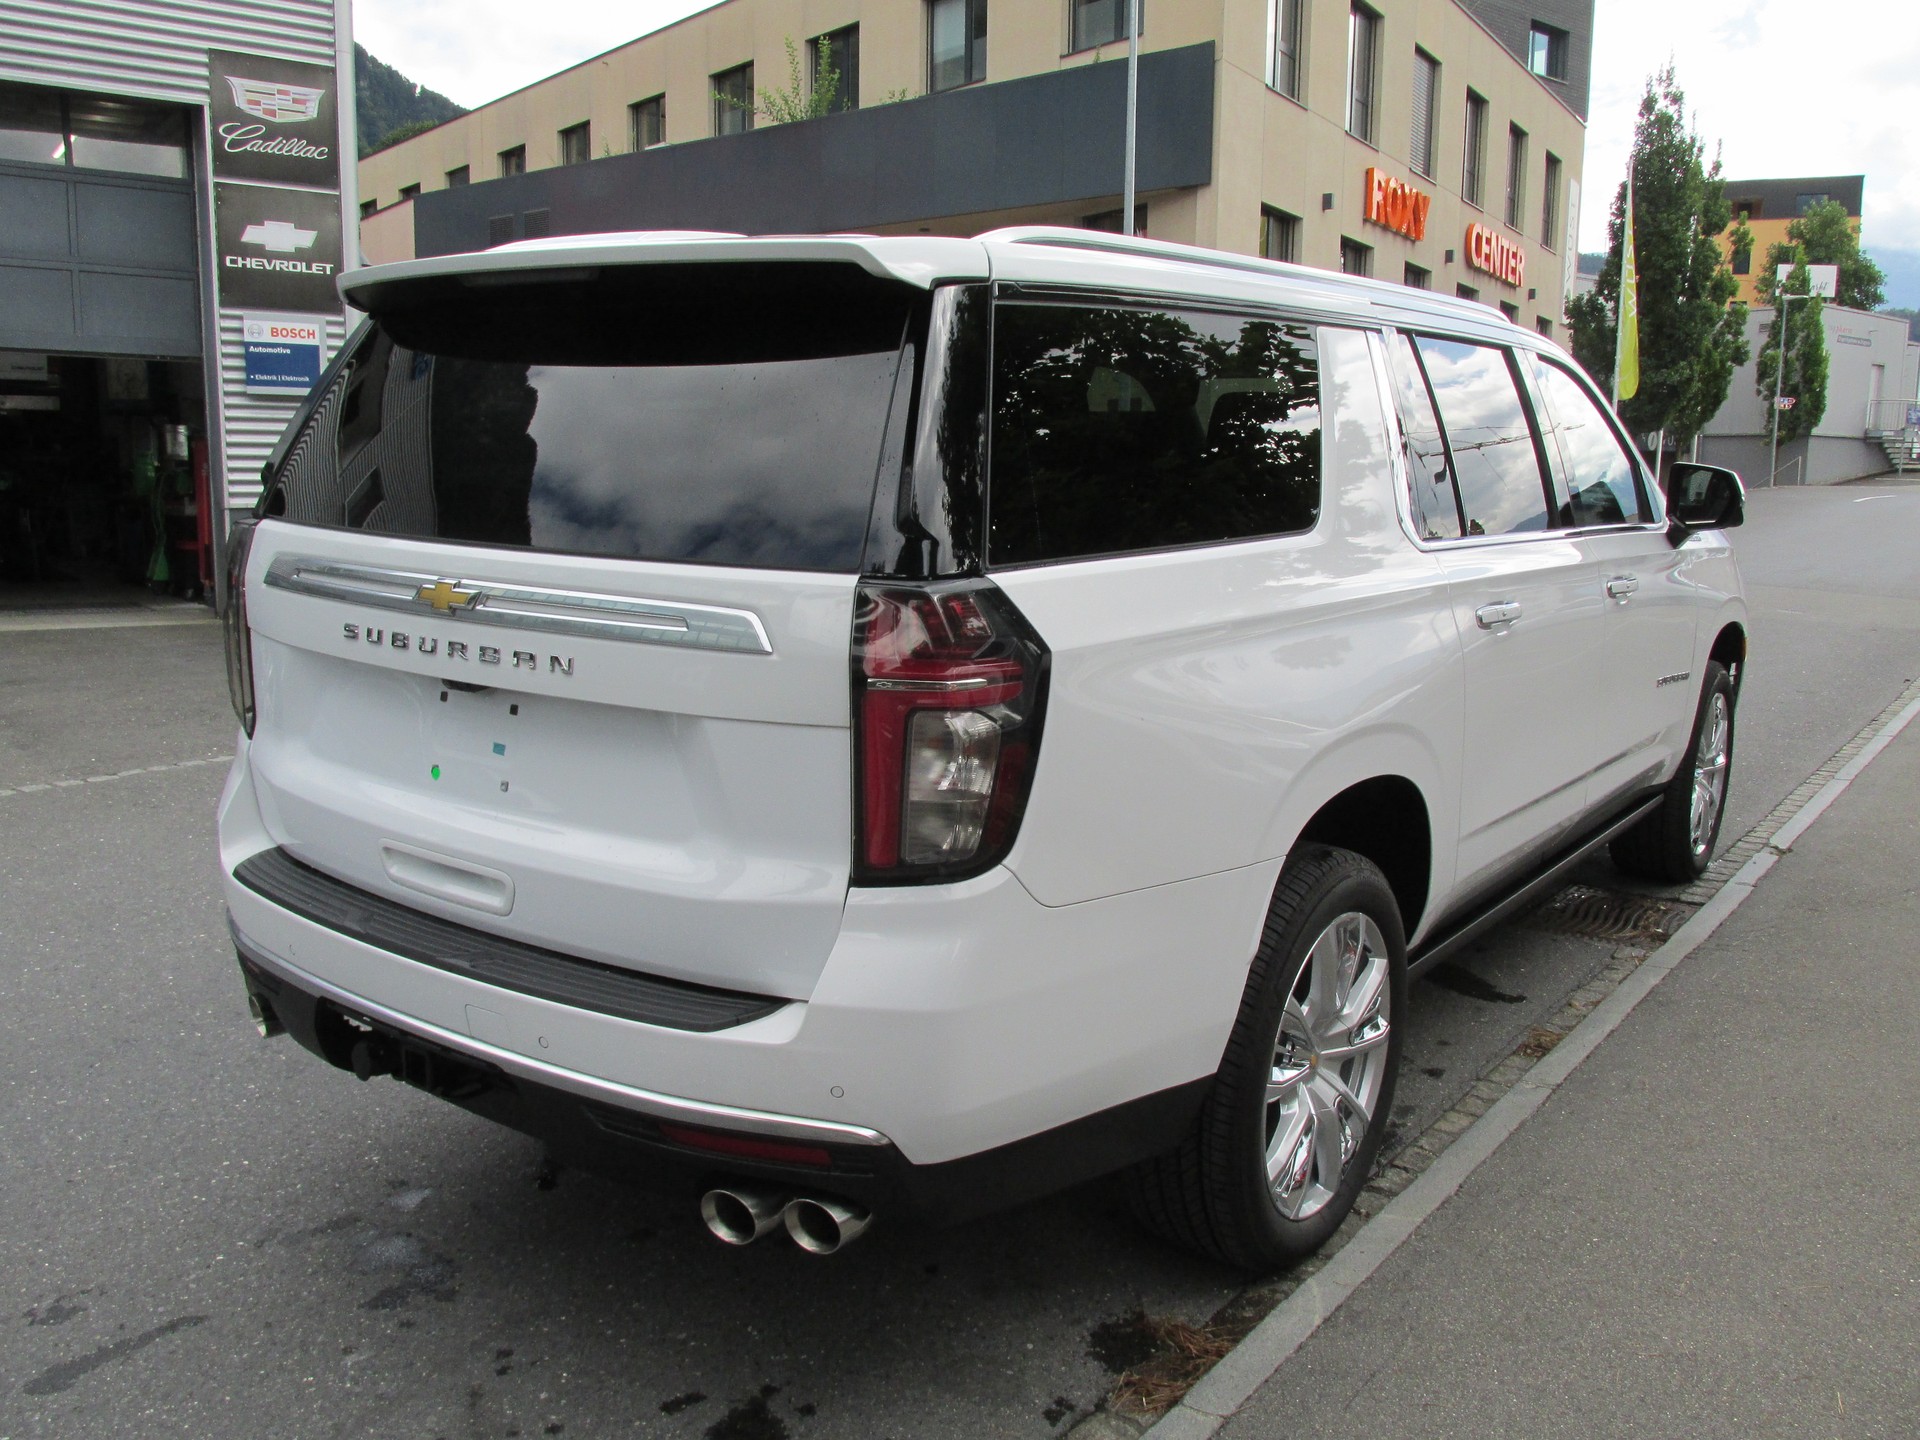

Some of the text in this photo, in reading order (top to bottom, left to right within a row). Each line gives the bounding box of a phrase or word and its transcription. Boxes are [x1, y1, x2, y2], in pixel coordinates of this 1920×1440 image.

[218, 121, 329, 160] Cadillac
[1365, 167, 1431, 241] ROXY
[225, 255, 334, 275] CHEVROLET
[1465, 222, 1525, 288] CENTER
[249, 345, 291, 354] Automotive
[270, 326, 316, 340] BOSCH
[343, 622, 575, 676] SUBURBAN
